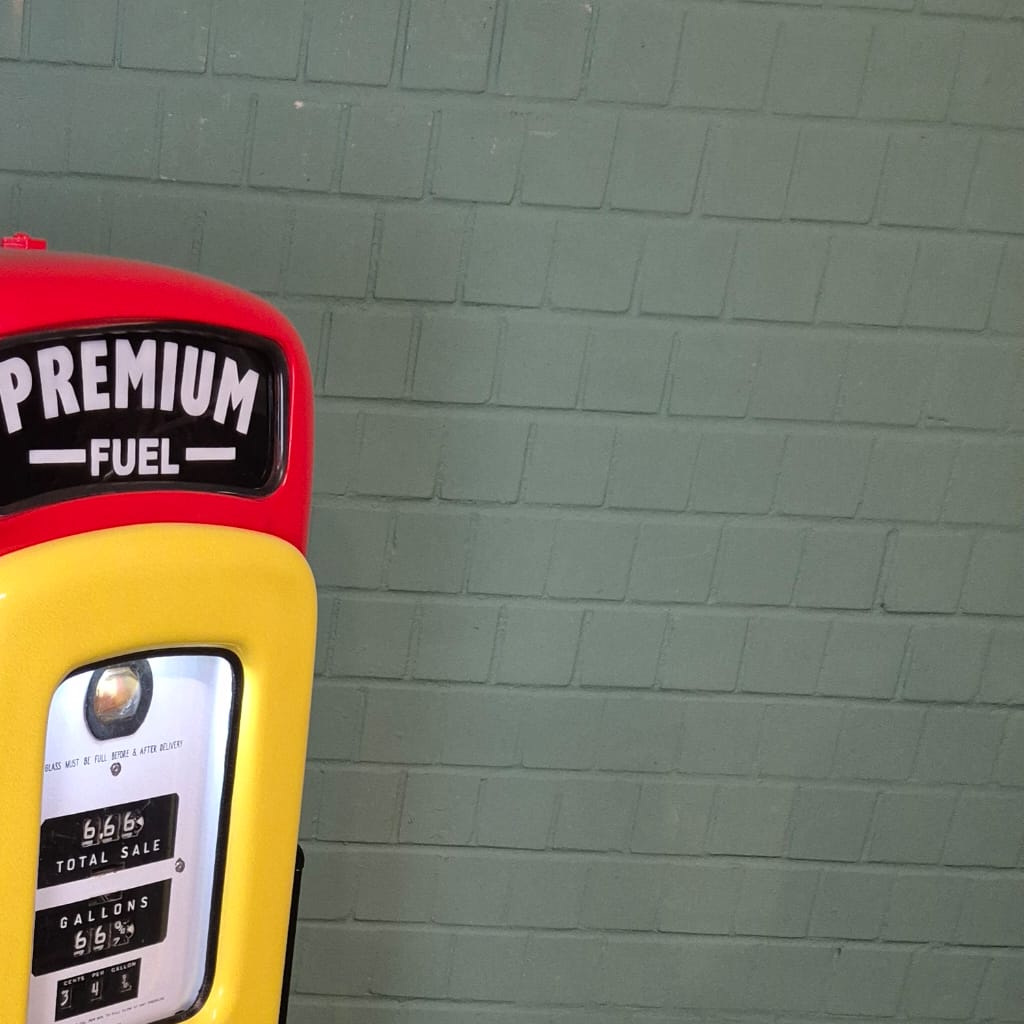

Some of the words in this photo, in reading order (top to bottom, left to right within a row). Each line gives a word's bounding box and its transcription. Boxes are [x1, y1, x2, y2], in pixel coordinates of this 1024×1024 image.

[90, 437, 180, 477] FUEL
[44, 761, 62, 773] GLASS
[65, 759, 79, 769] MUST
[83, 756, 91, 766] BE
[94, 754, 107, 764] FULL
[111, 749, 130, 761] BEFORE
[139, 744, 157, 756] AFTER
[160, 740, 183, 752] DELIVERY
[56, 852, 109, 874] TOTAL
[120, 839, 161, 859] SALE
[60, 896, 149, 929] GALLONS
[63, 975, 85, 986] CENTS
[91, 970, 105, 979] PER
[111, 962, 137, 973] GALLON
[91, 981, 99, 996] 4
